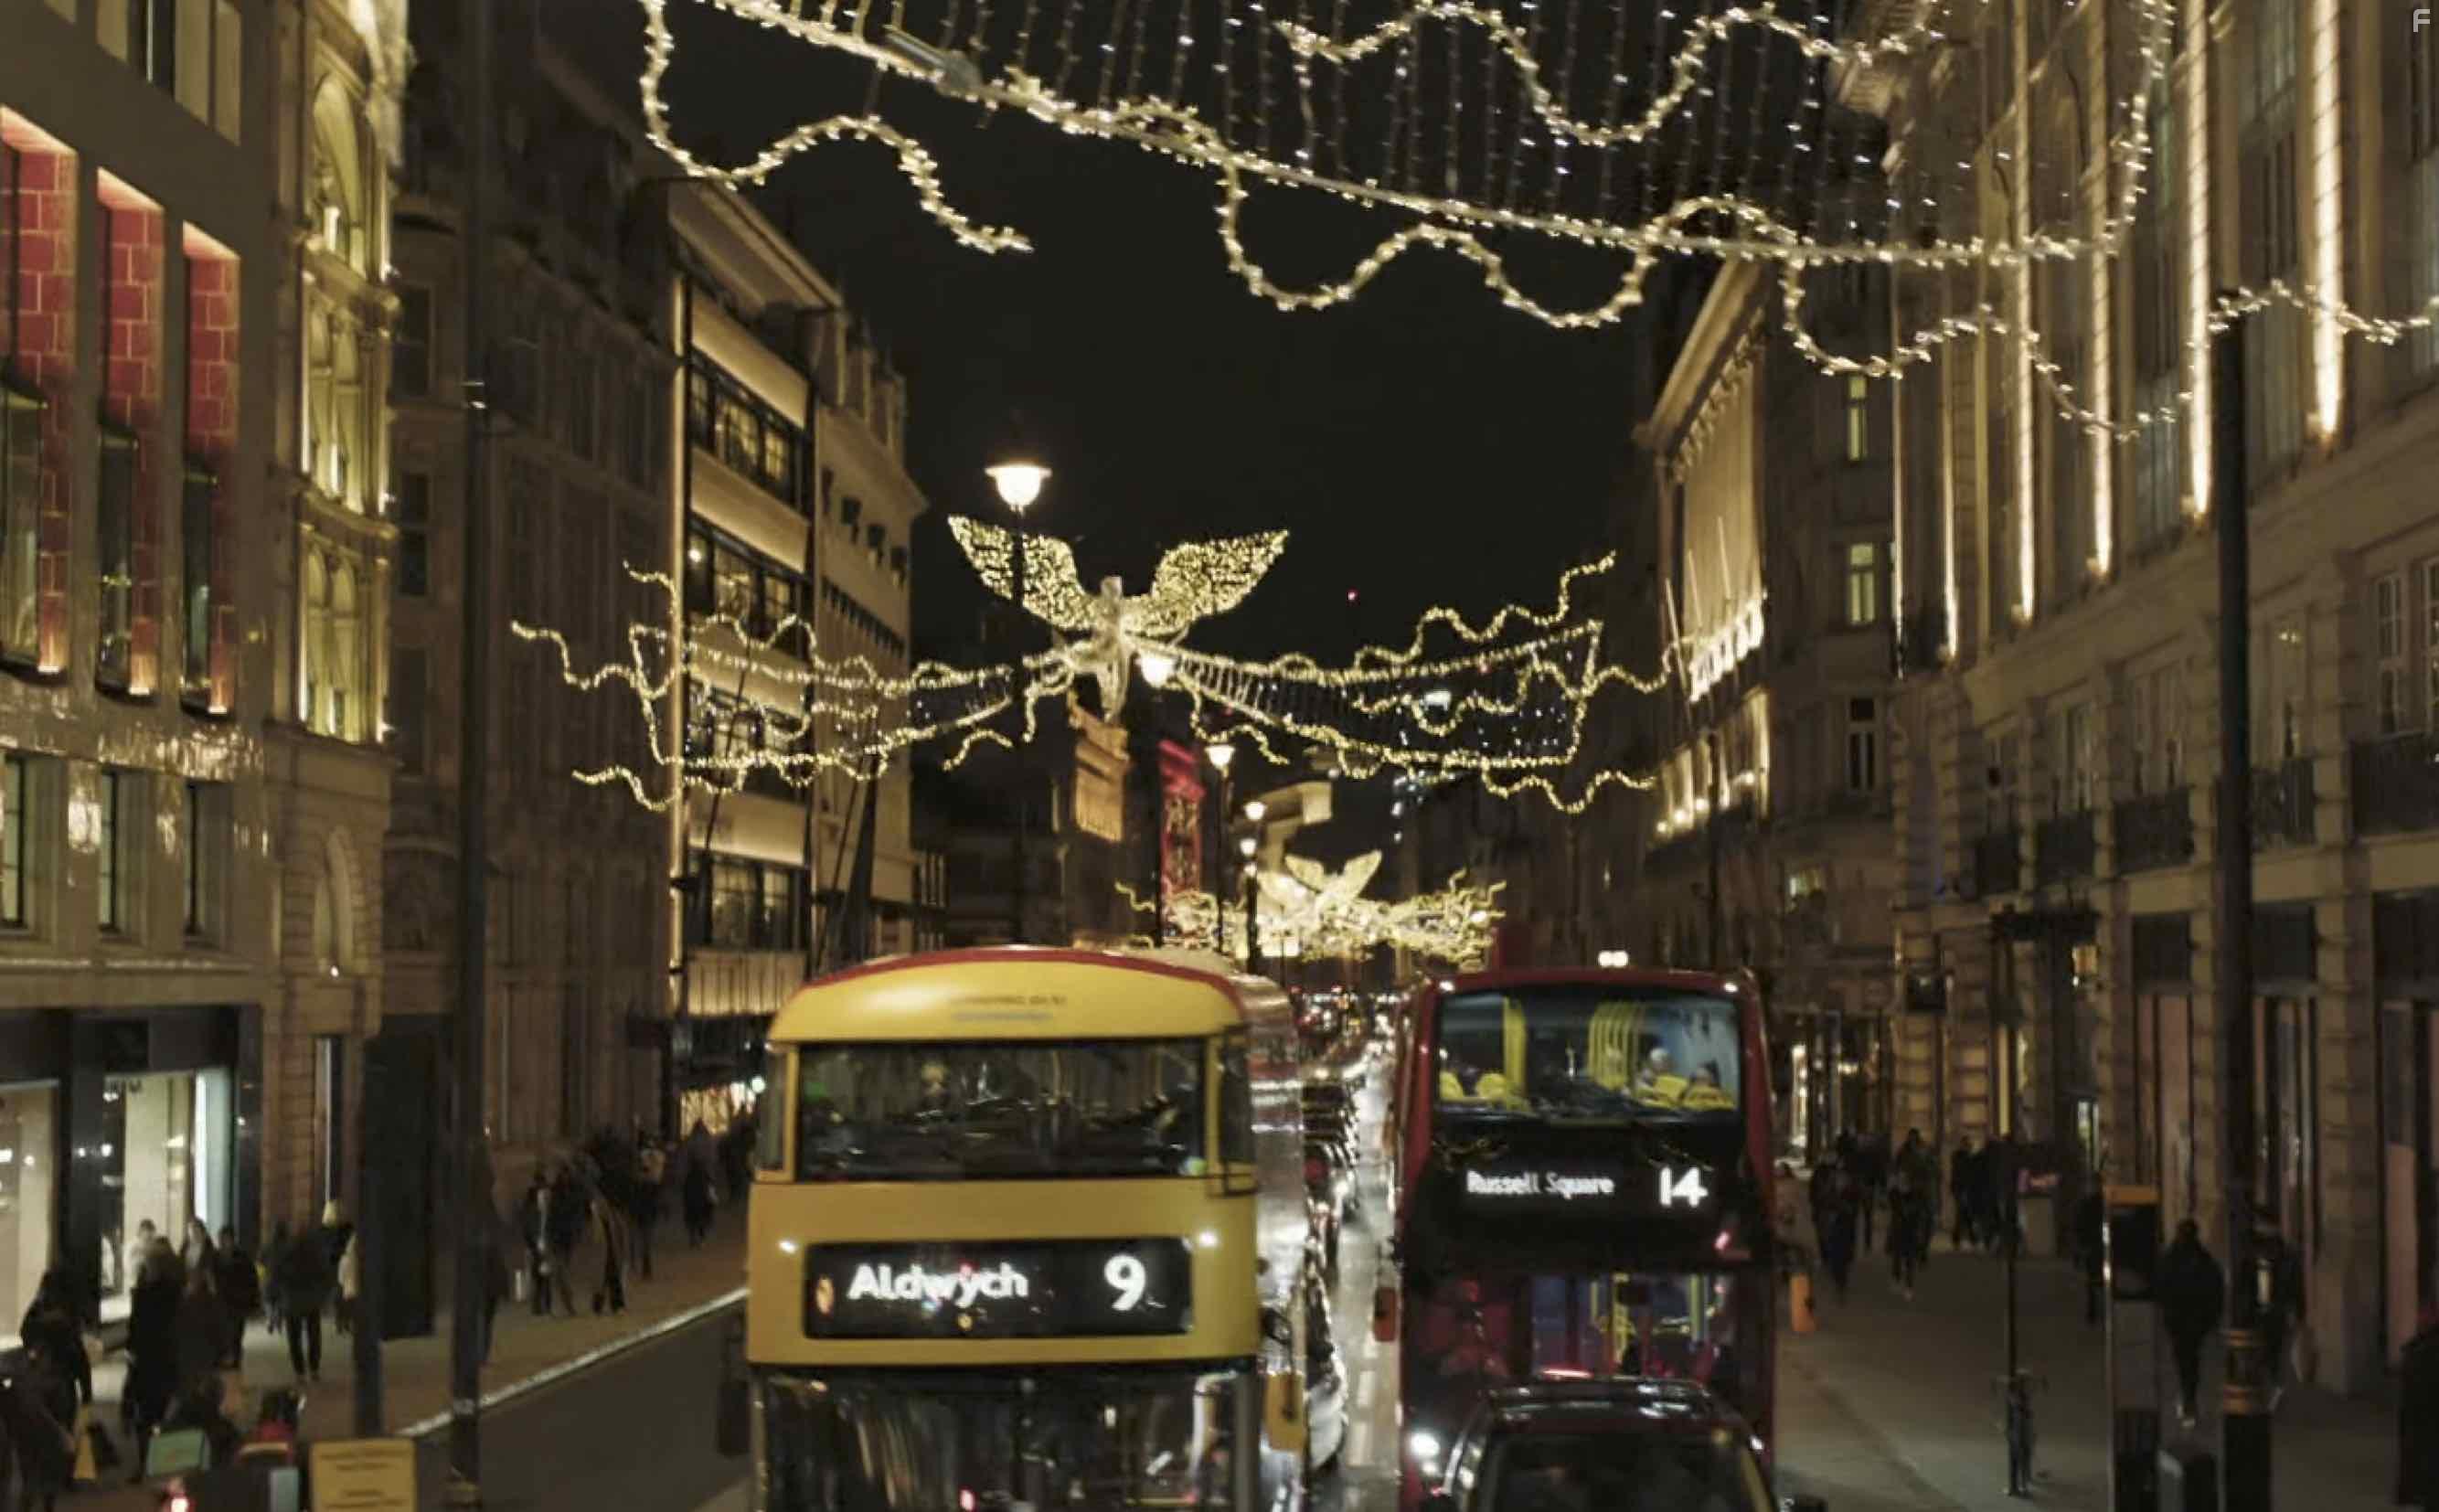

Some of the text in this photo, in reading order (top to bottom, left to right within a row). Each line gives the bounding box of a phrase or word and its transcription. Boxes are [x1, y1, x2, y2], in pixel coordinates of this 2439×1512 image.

[1466, 1166, 1709, 1206] Russell Square 14
[847, 1253, 1146, 1311] Aldwych 9
